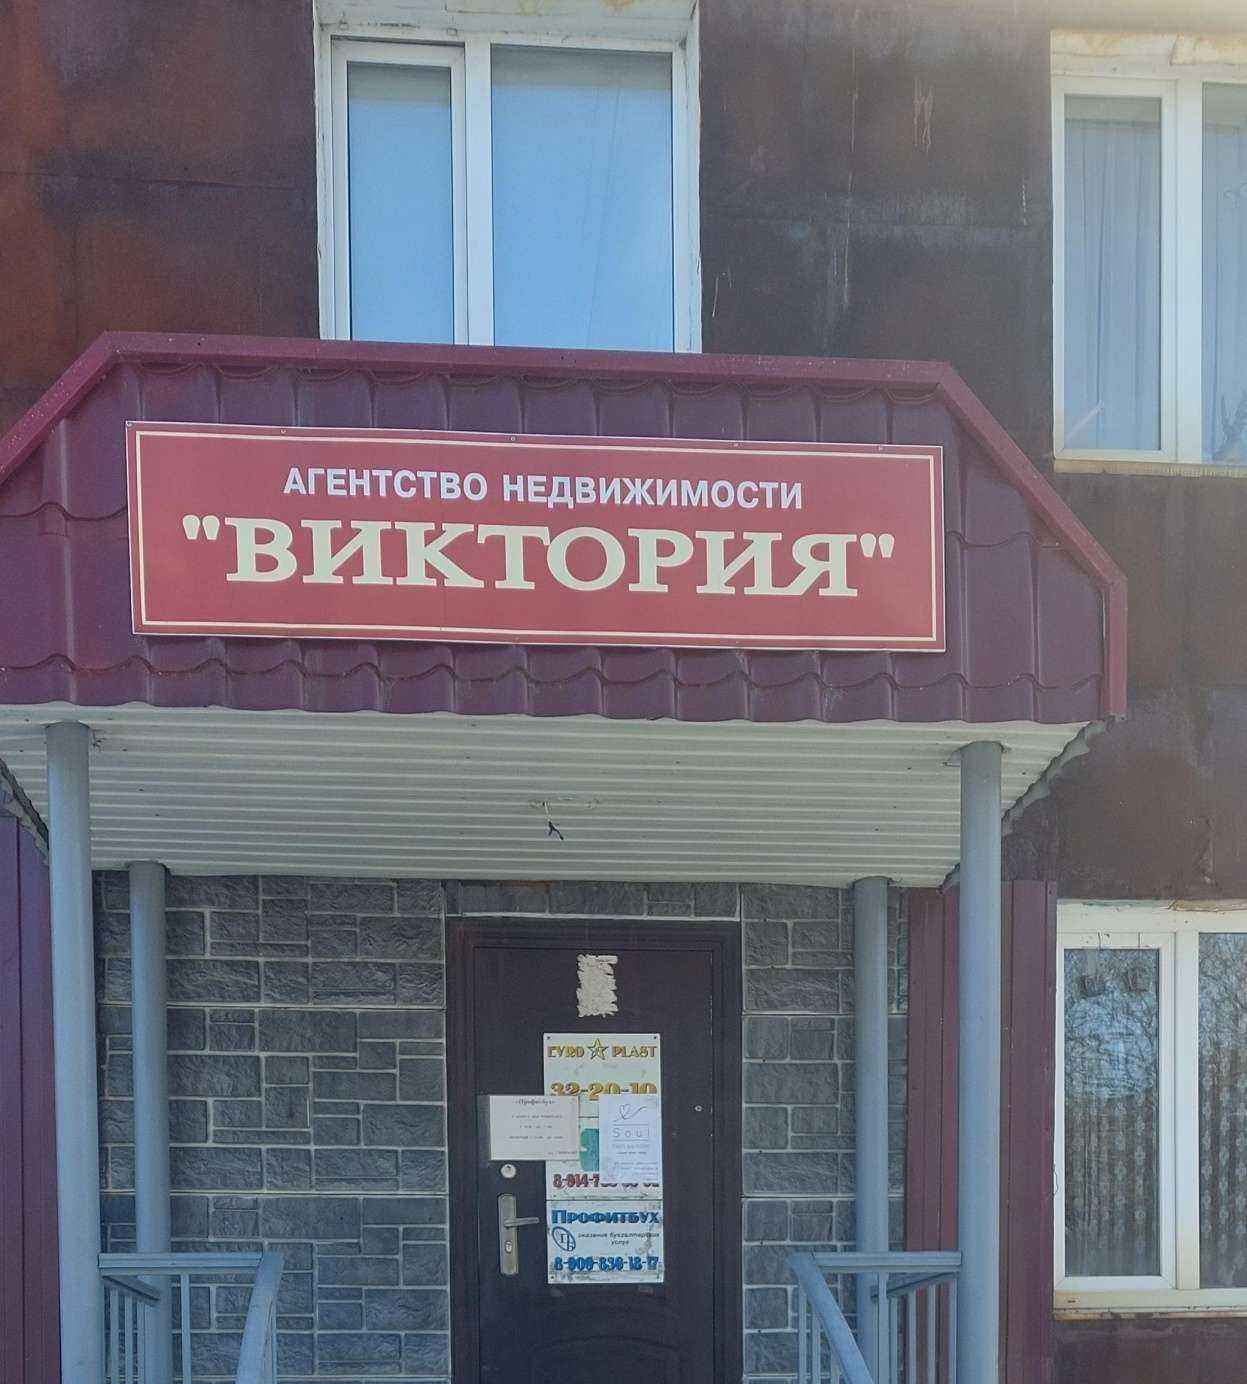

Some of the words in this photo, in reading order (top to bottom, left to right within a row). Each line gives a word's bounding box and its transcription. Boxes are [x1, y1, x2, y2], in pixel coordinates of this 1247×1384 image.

[283, 467, 488, 501] АГЕНТСТВО
[502, 473, 802, 510] НЕДВИЖИМОСТИ
[182, 514, 895, 597] "ВИКТОРИЯ"
[612, 1046, 657, 1058] PLAST
